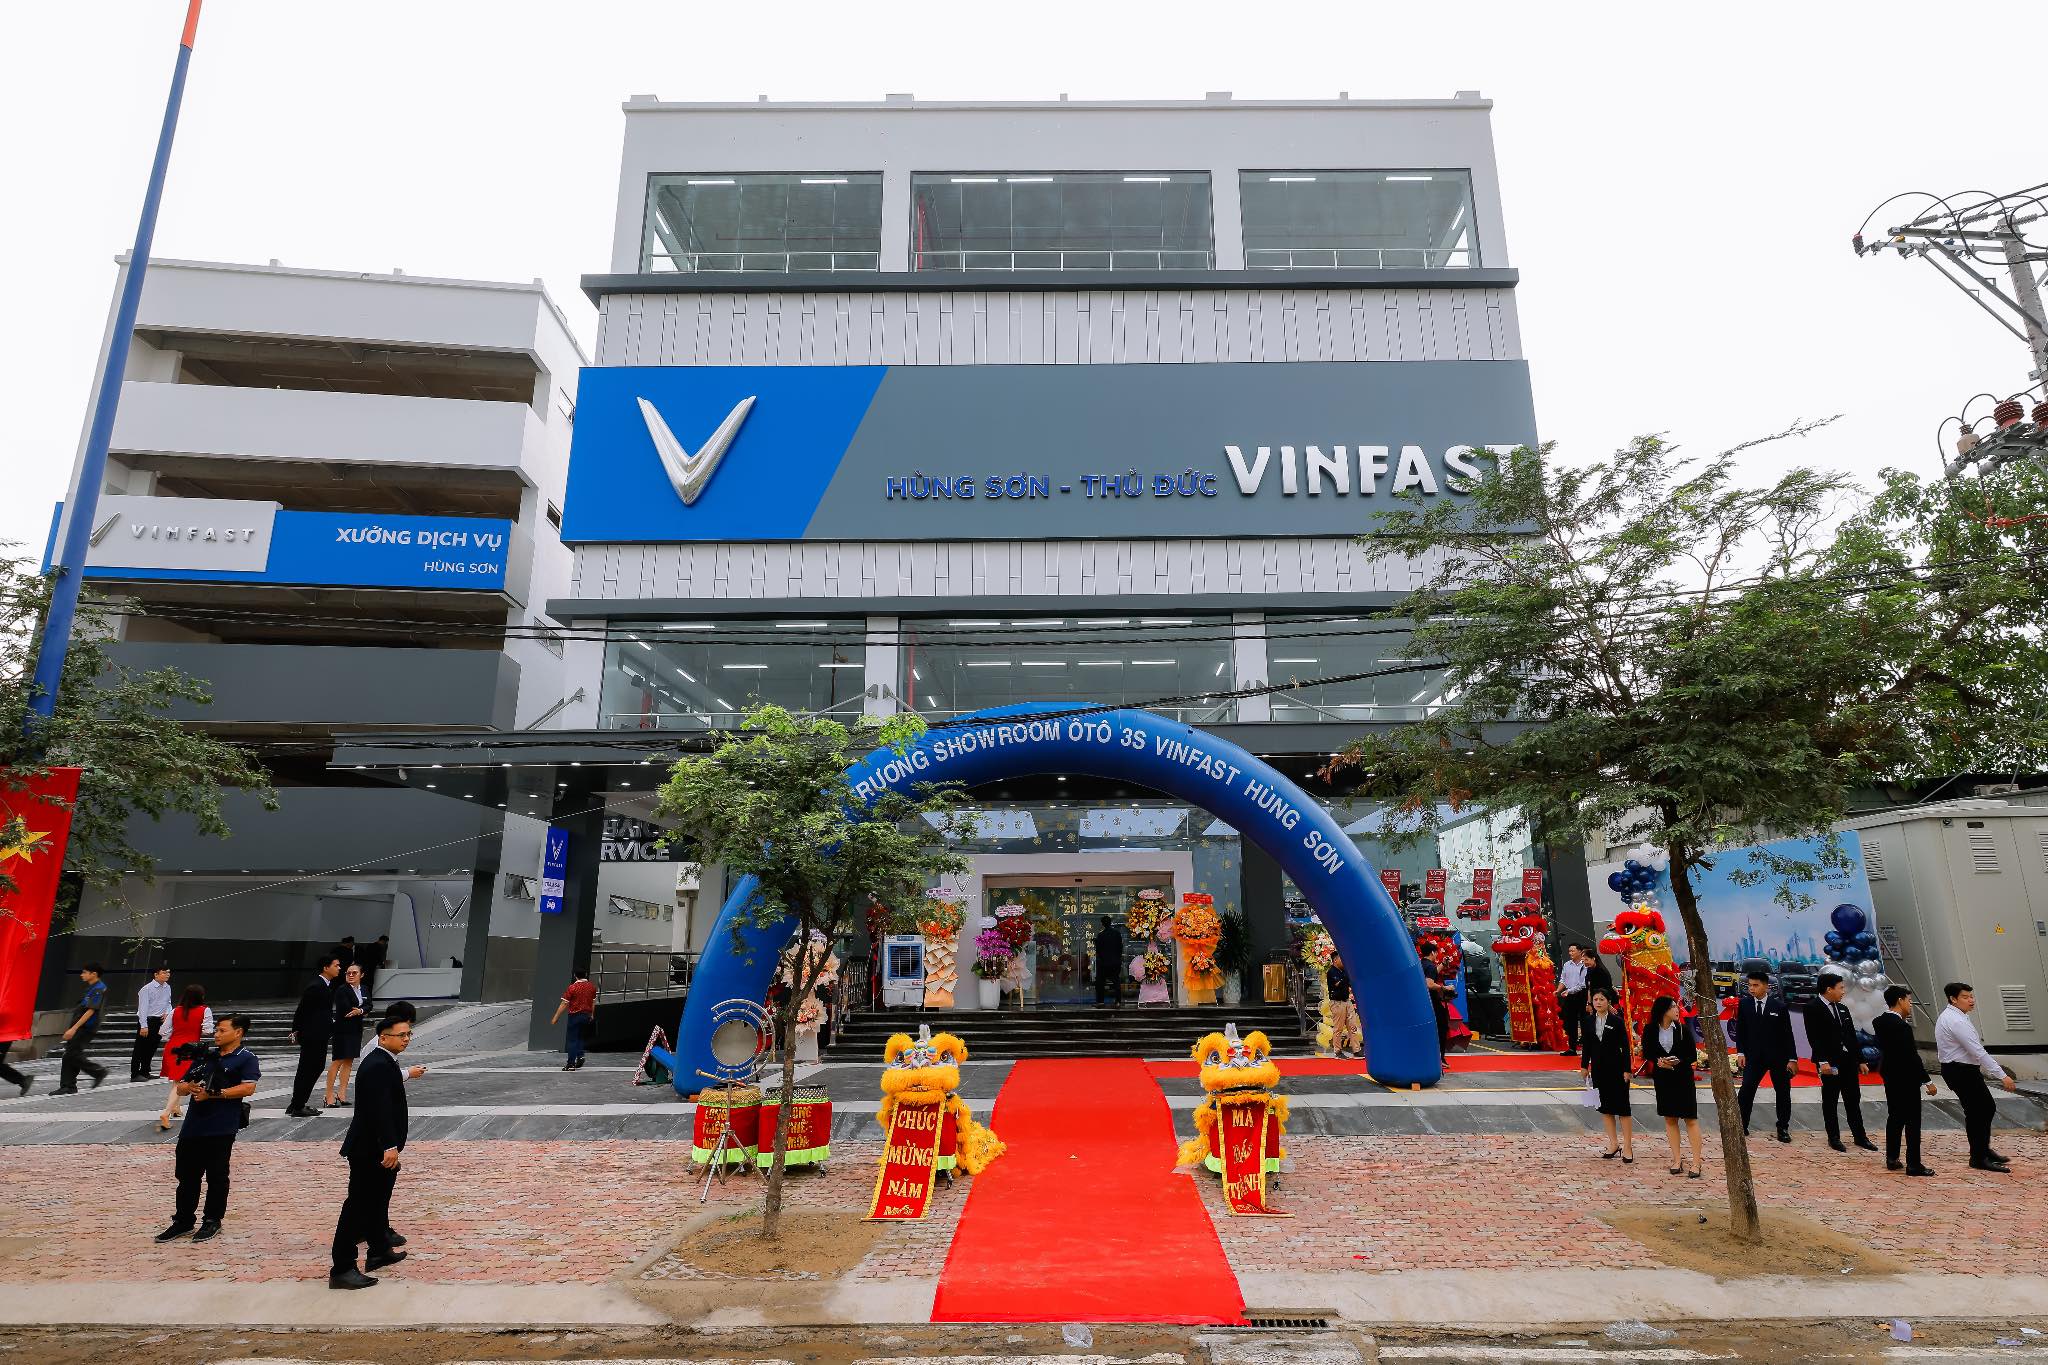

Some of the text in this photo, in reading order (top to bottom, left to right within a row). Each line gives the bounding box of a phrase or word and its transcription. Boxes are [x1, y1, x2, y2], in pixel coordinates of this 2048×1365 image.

[886, 470, 975, 499] HÙNG
[984, 471, 1049, 499] SƠN
[1080, 467, 1144, 499] THỦ
[1151, 467, 1218, 497] ĐỨC
[131, 524, 255, 543] VINFAST
[336, 525, 502, 551] XƯỞNG DỊCH VỤ
[424, 559, 499, 574] HÙNG SƠN
[851, 750, 930, 800] RƯƠNG
[933, 721, 1060, 762] SHOWROOM
[1120, 727, 1147, 750] 3S
[1155, 735, 1240, 786] VINFAST
[1244, 778, 1300, 830] HÙNG
[1303, 830, 1344, 875] SƠN
[897, 1105, 937, 1131] CHÚC
[888, 1139, 934, 1167] MỪNG
[886, 1178, 923, 1200] NĂM
